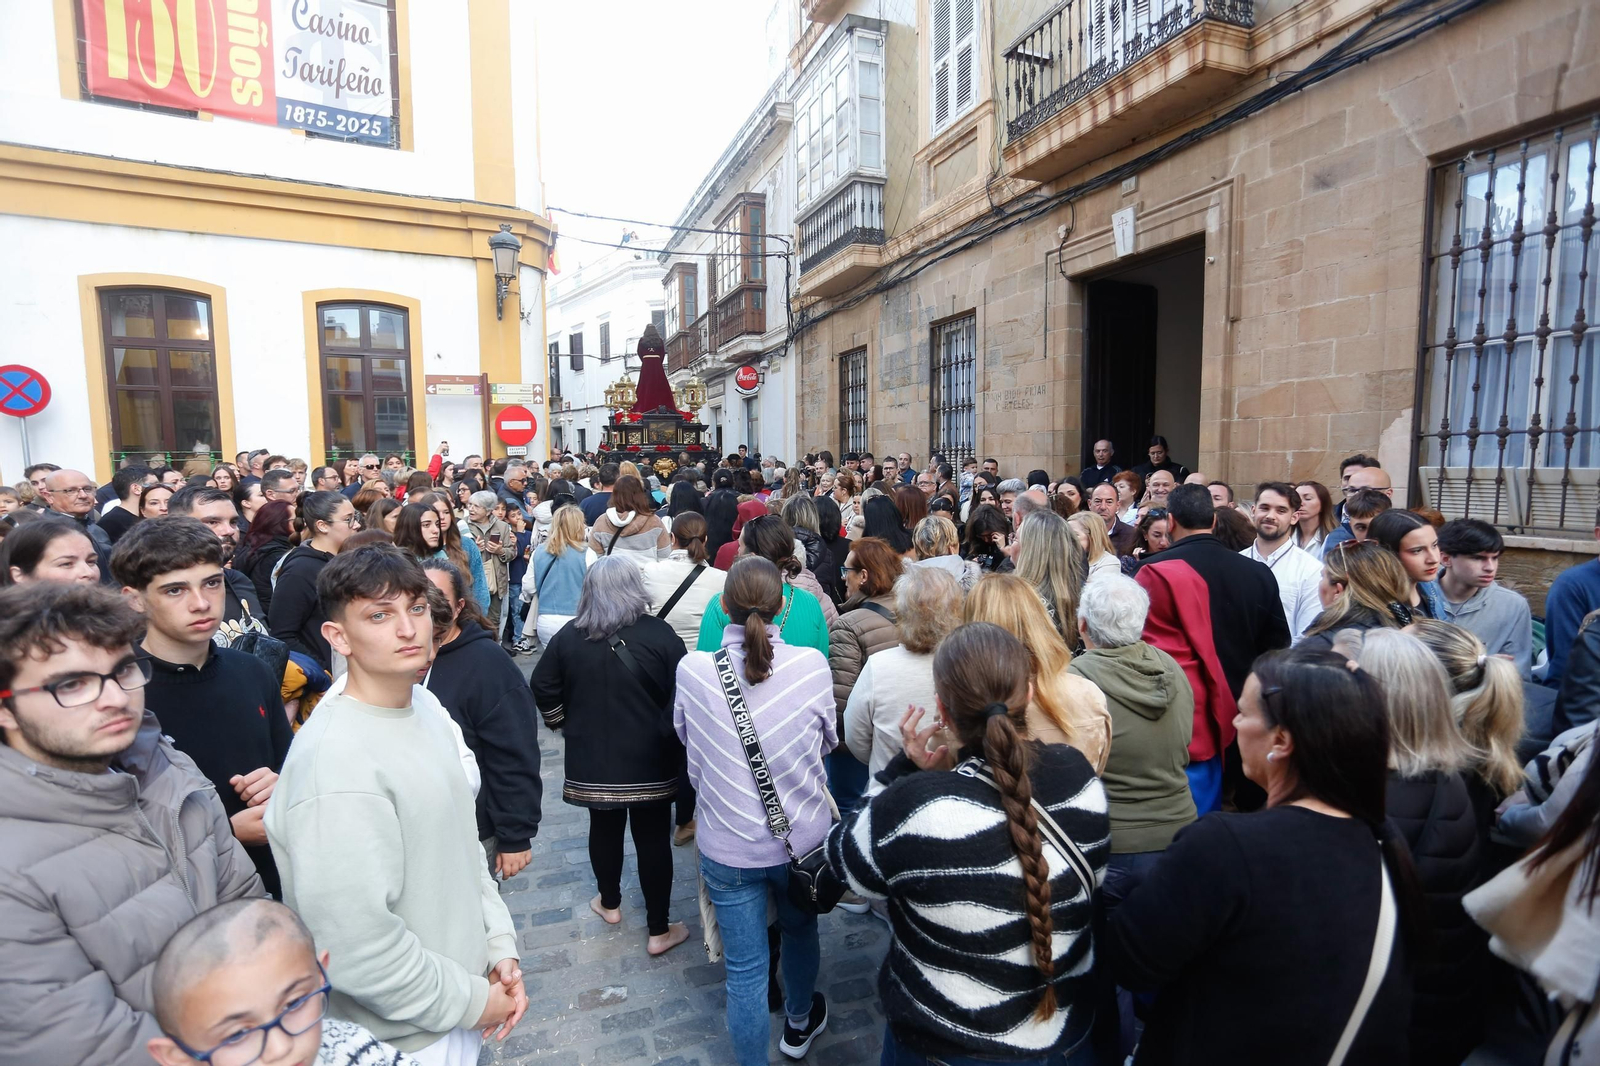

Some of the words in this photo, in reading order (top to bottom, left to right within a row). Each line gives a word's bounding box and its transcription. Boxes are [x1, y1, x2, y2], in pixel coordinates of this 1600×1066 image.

[291, 0, 372, 45] Casino
[282, 46, 384, 99] Tarifeño
[285, 104, 382, 136] 1875-2025
